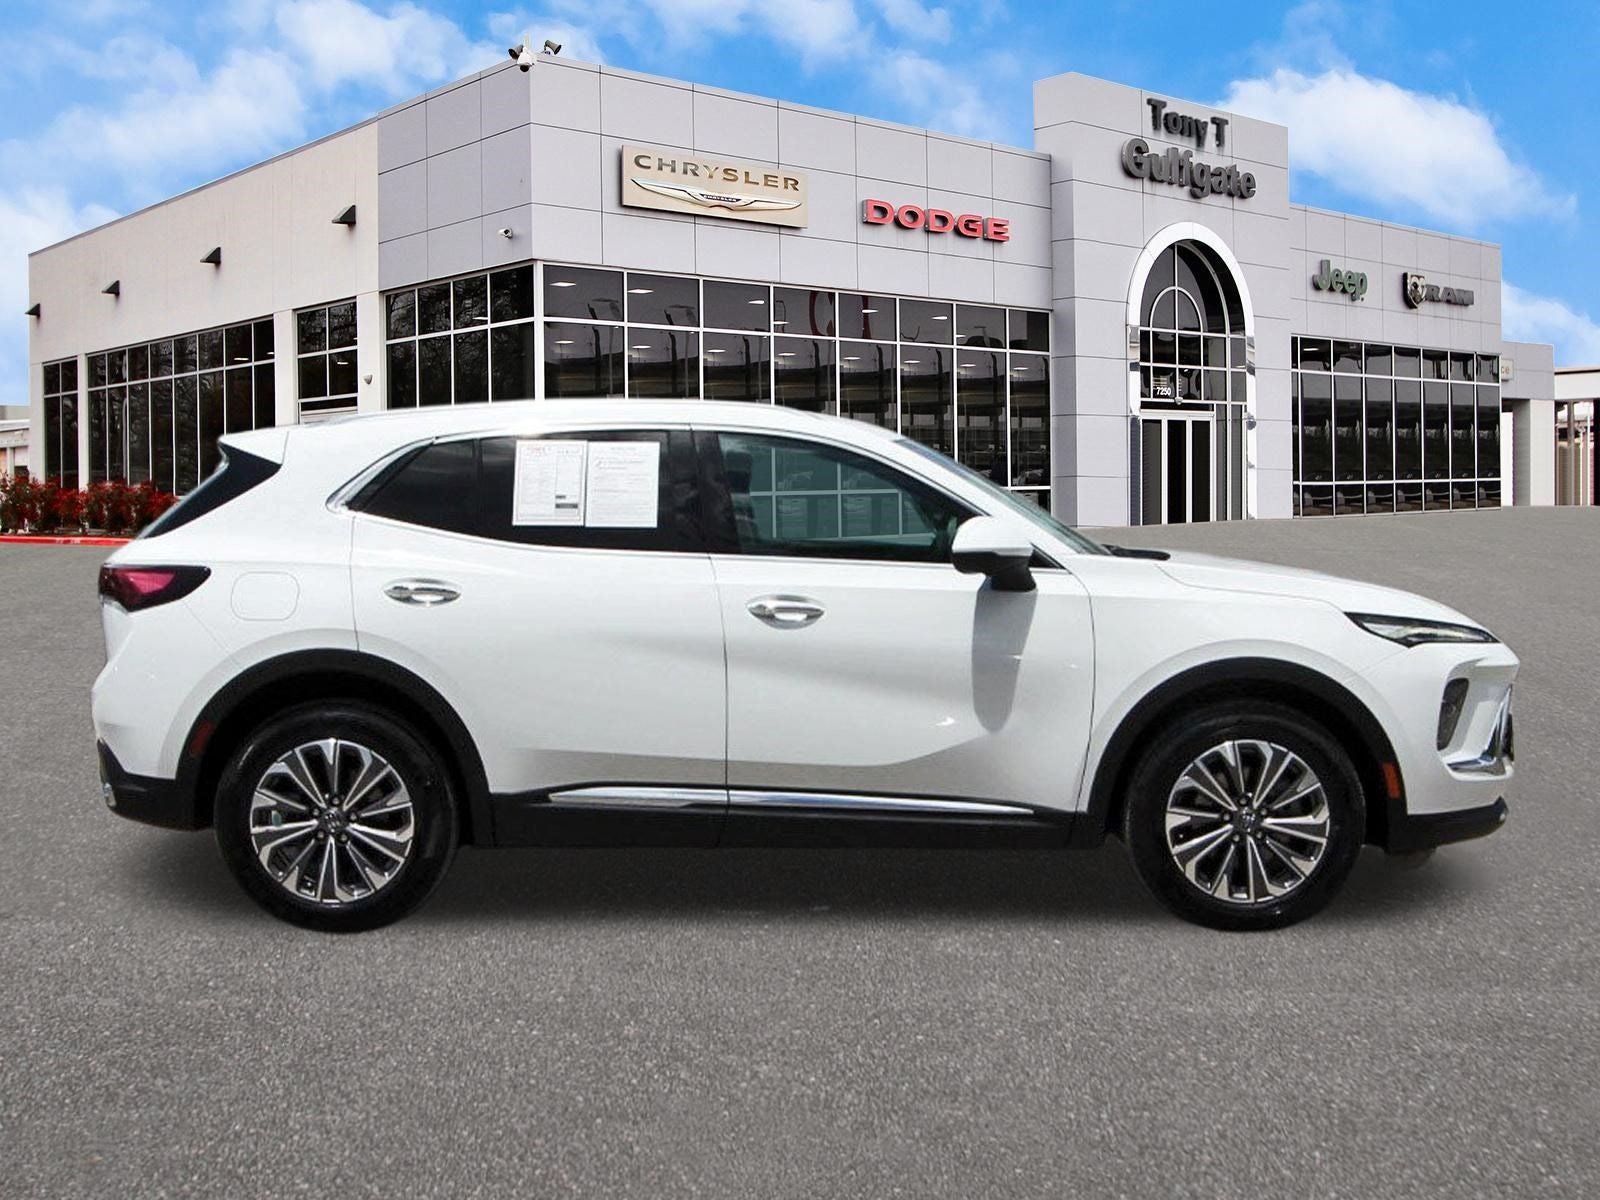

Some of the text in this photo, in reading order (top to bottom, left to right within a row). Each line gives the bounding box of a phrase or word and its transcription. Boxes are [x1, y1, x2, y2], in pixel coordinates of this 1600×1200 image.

[1147, 98, 1229, 147] Tony T
[634, 154, 800, 191] CHRYSLER
[1121, 138, 1257, 199] Gulfgate
[862, 199, 1010, 242] DODGE
[1312, 260, 1368, 301] Jeep
[1425, 284, 1474, 306] RAM
[1156, 386, 1172, 396] 7250
